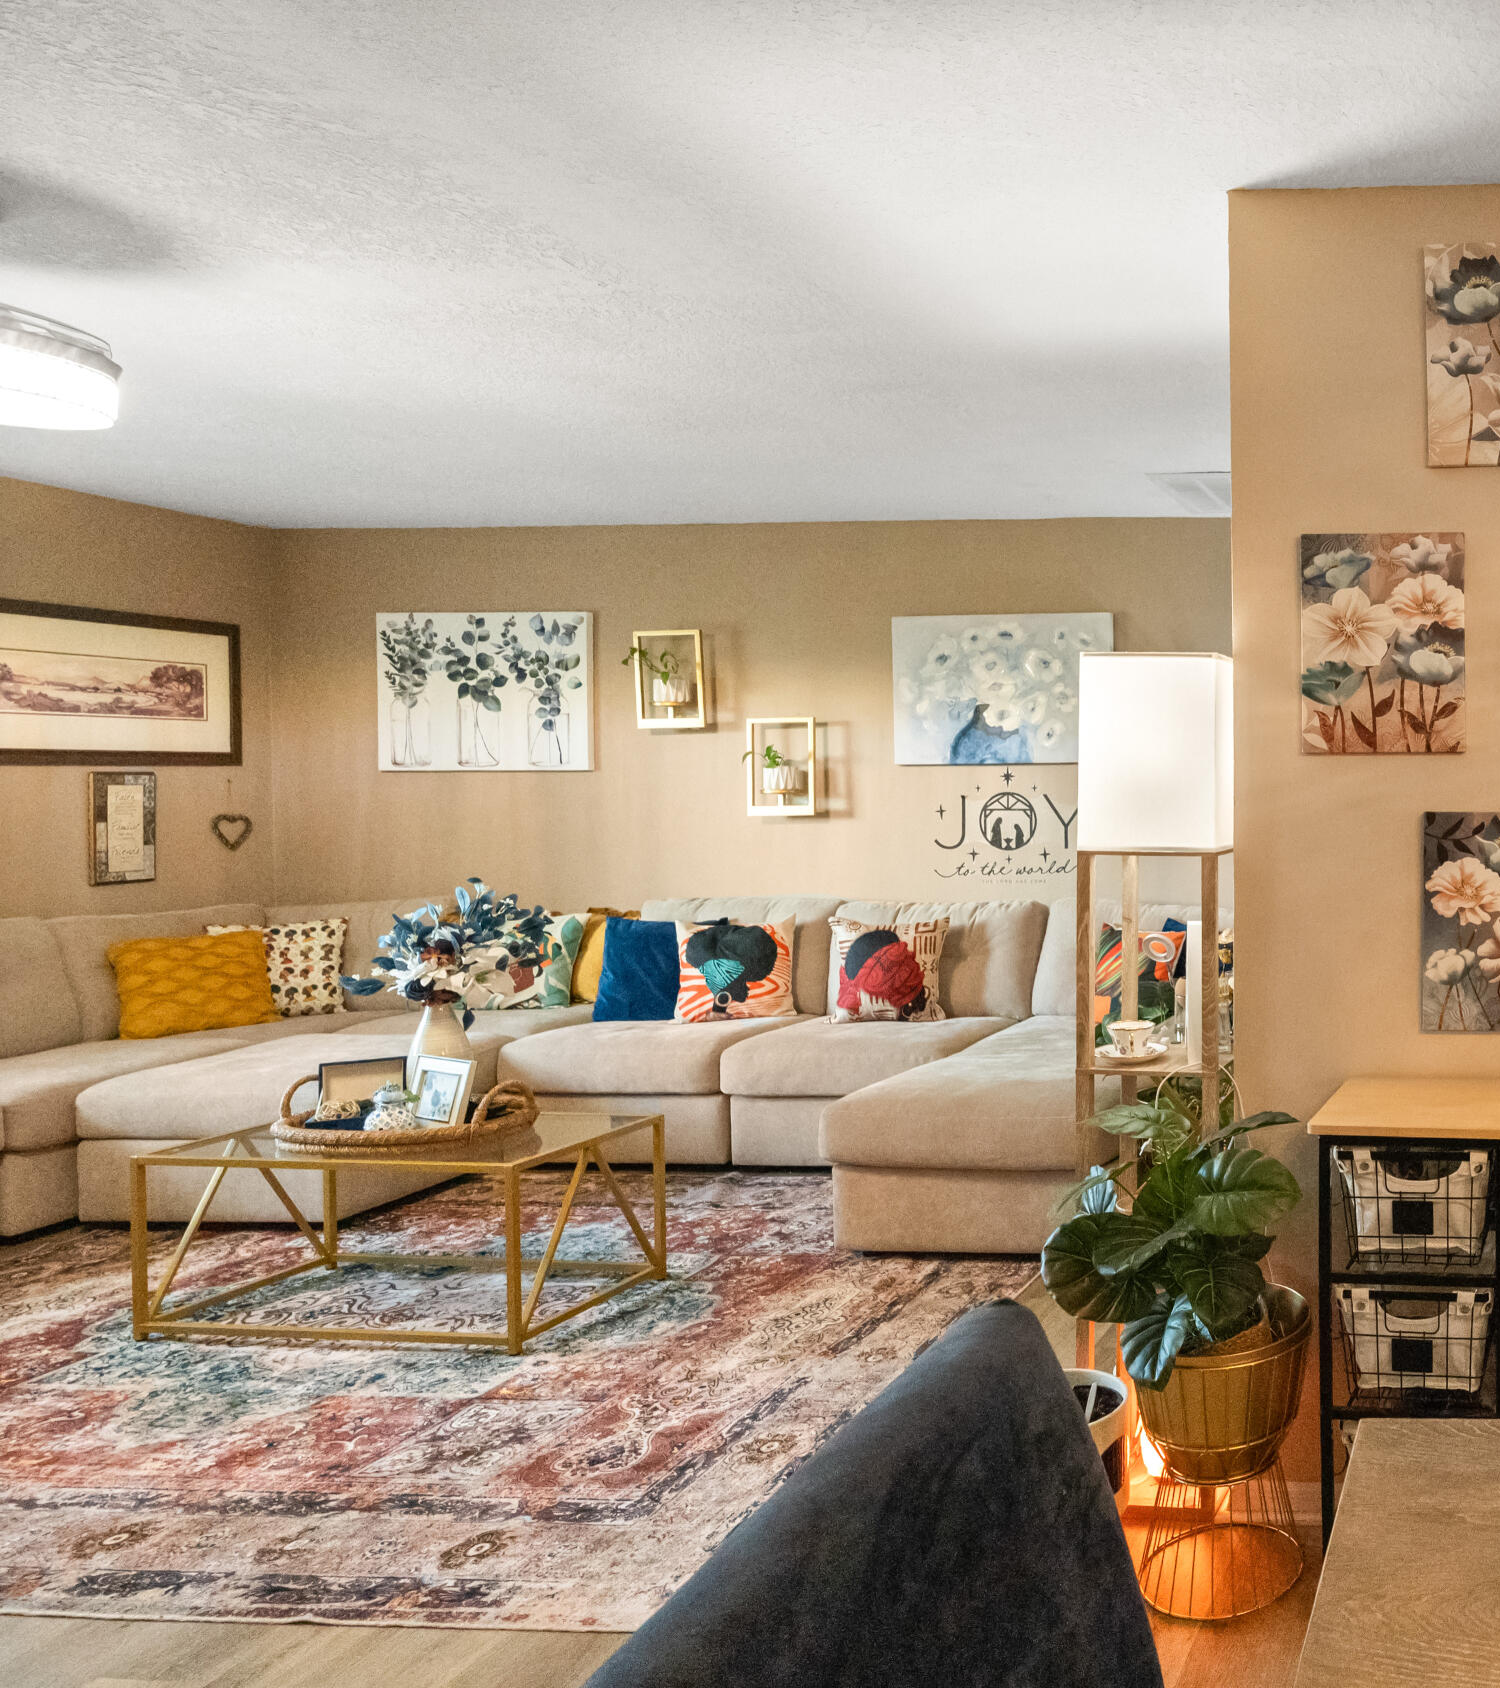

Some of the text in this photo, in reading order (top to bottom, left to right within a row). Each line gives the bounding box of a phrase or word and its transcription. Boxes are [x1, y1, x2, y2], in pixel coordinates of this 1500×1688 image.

[934, 791, 1078, 850] JOY
[945, 859, 1077, 878] to the world
